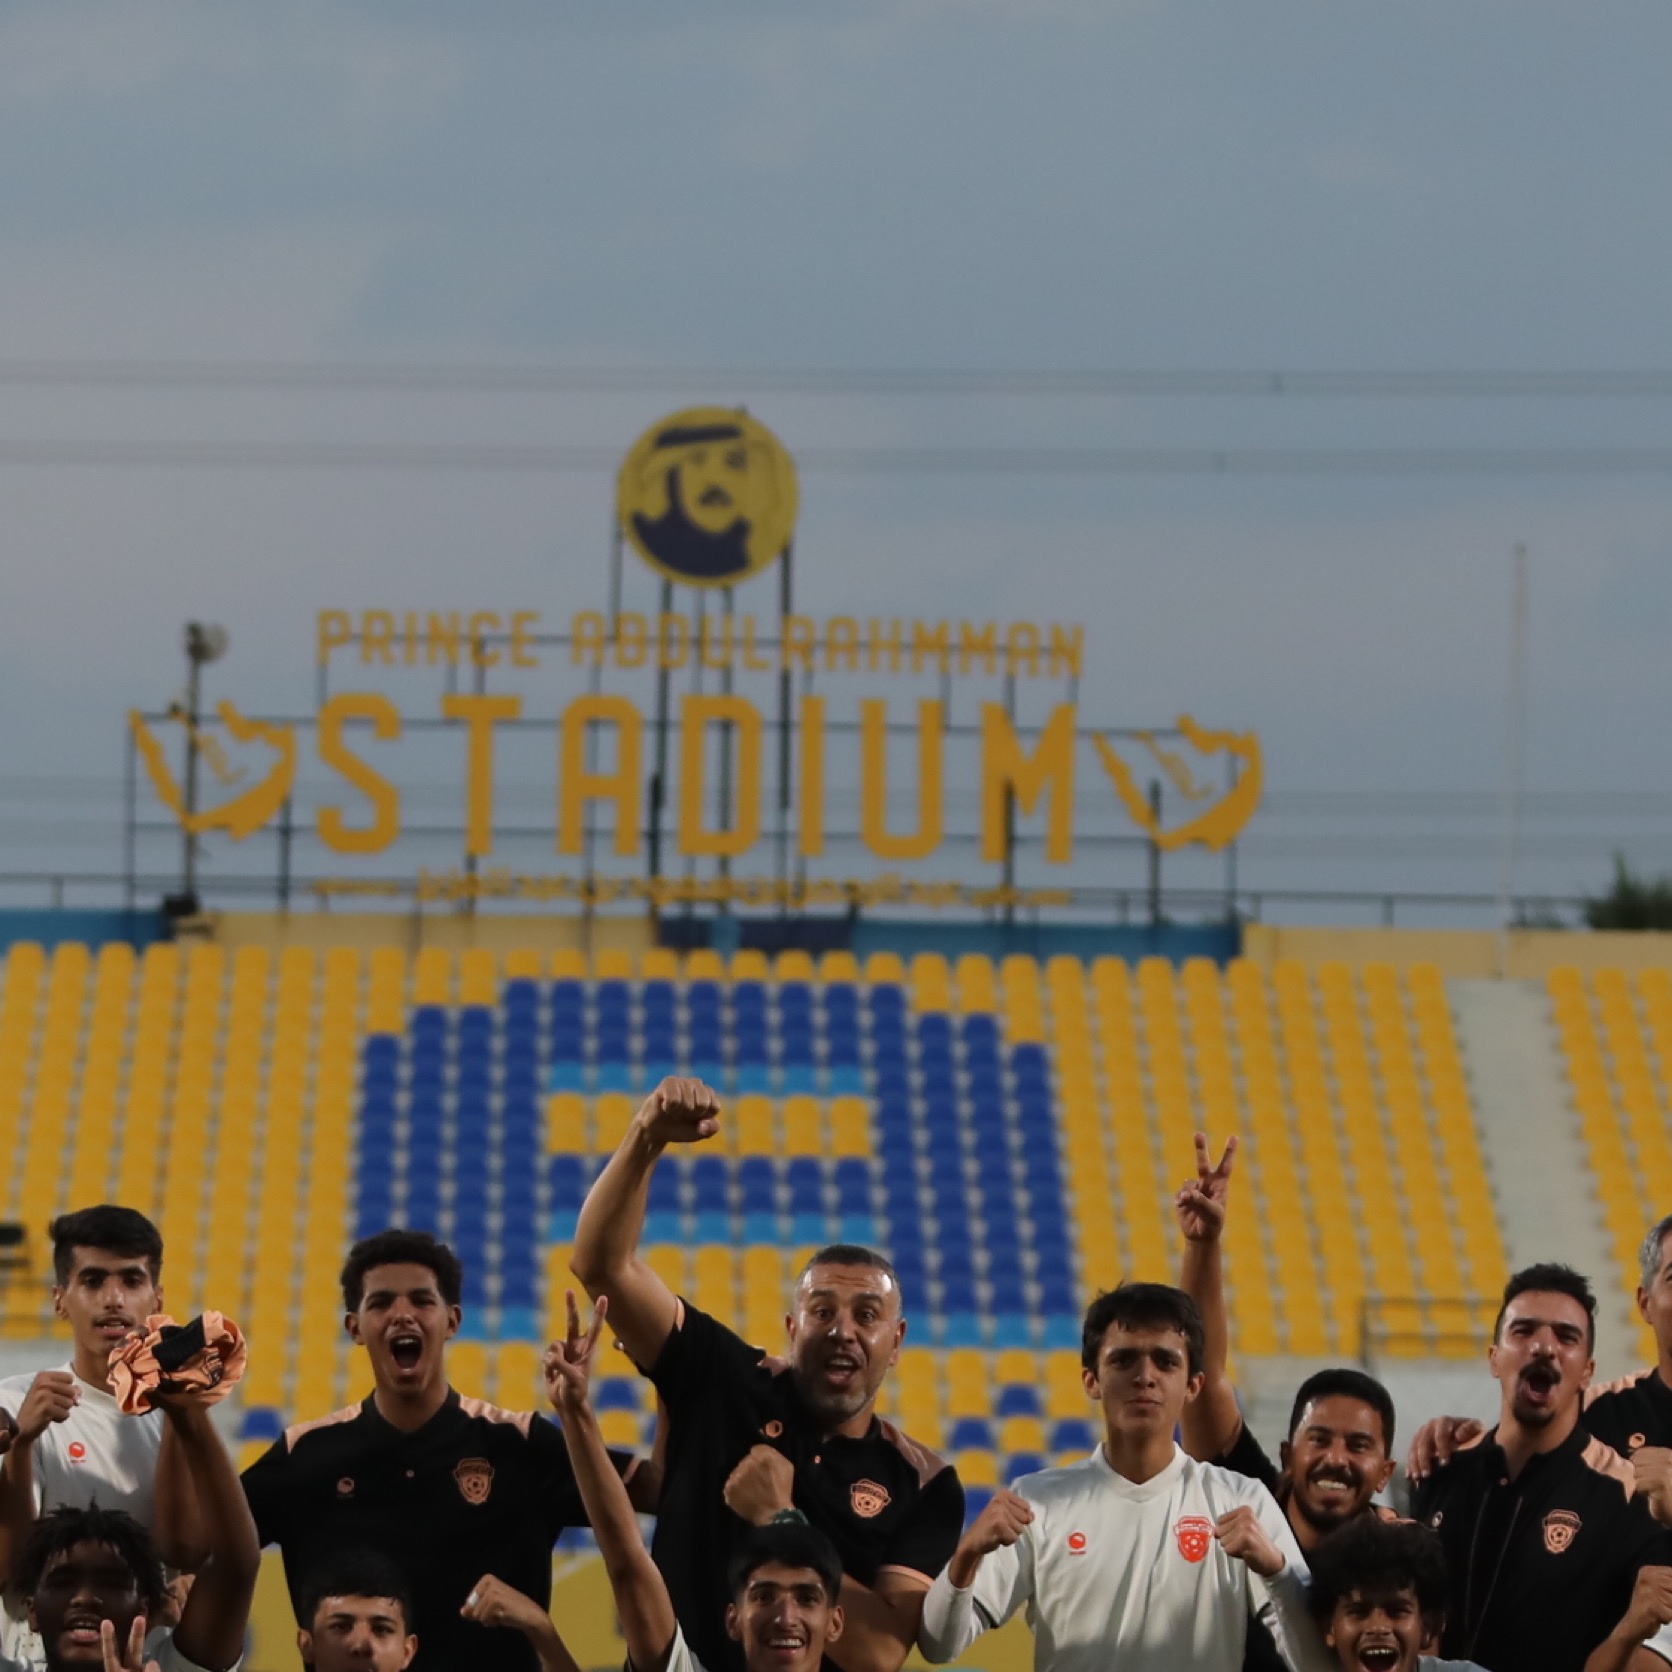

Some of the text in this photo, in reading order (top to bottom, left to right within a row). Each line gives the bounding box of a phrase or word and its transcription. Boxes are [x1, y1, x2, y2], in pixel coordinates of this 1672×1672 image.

[316, 608, 1085, 678] PRINCE ABDULRAHMMAN
[316, 693, 1075, 863] STADIUM
